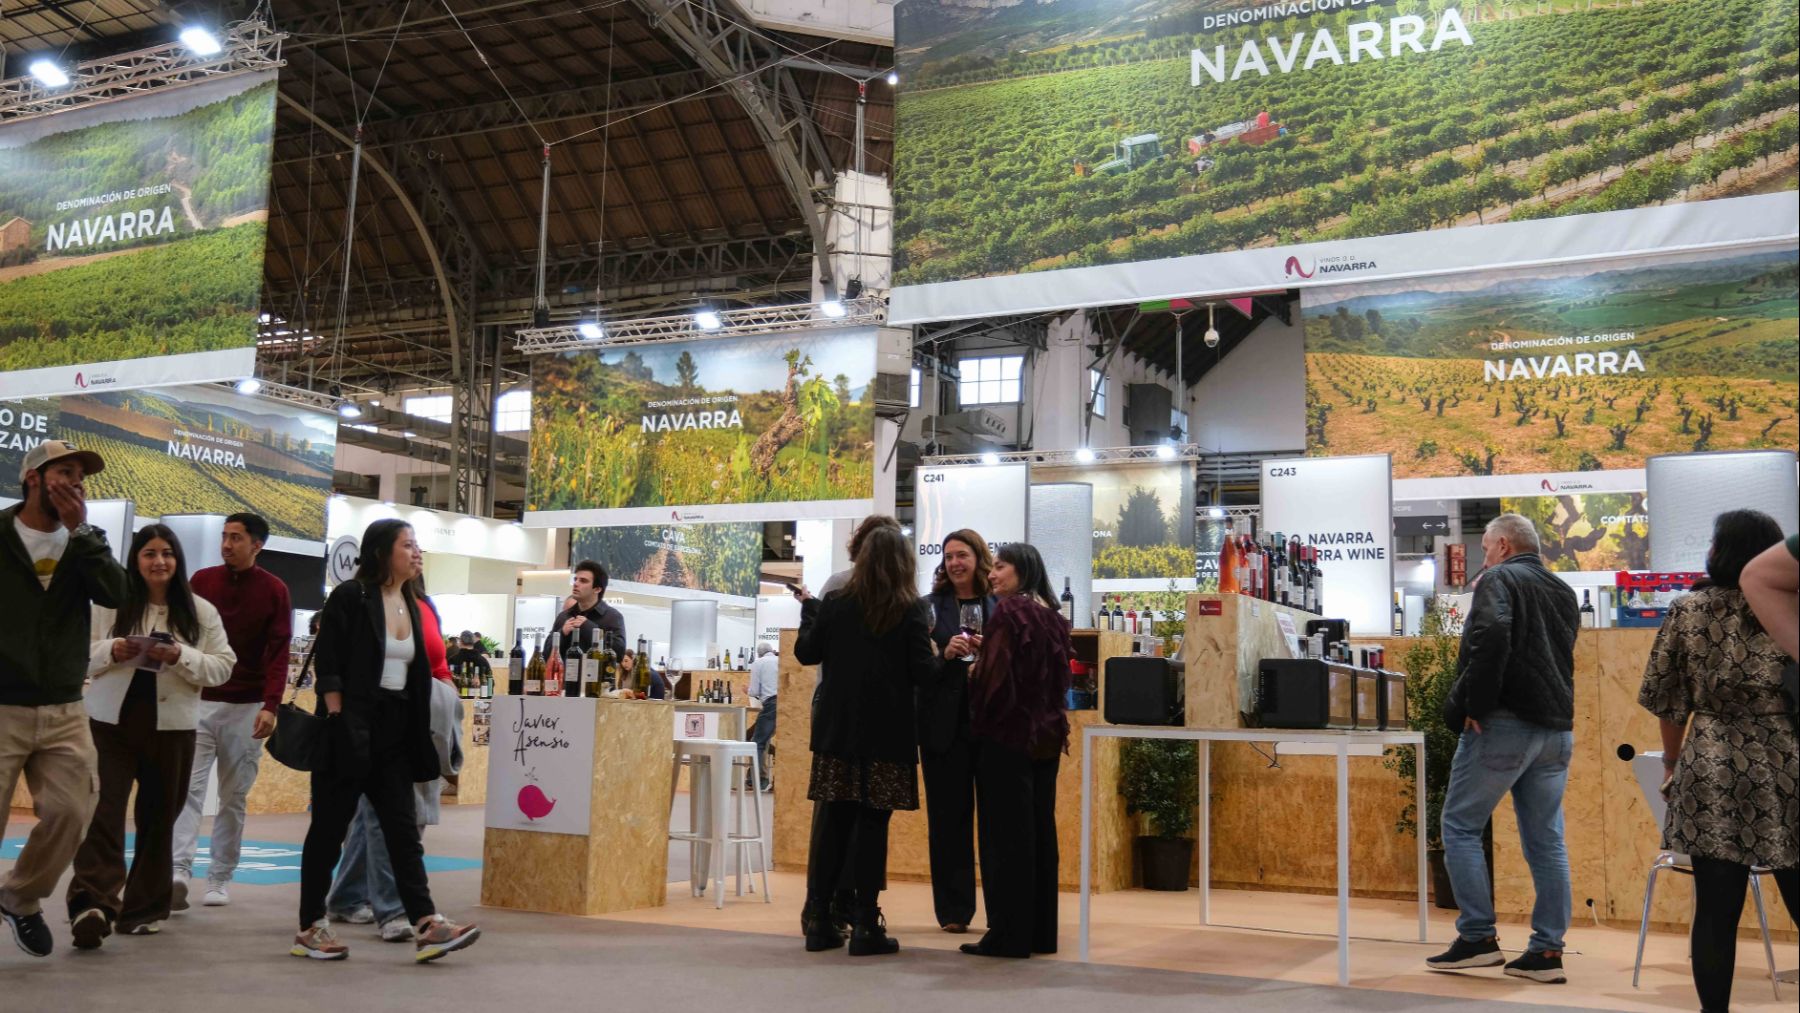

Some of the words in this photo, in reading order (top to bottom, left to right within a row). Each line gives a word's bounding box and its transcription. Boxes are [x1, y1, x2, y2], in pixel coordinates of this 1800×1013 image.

[1190, 8, 1473, 87] NAVARRA
[57, 192, 121, 211] DENOMINACIÓN
[124, 189, 136, 199] DE
[137, 184, 171, 197] ORIGEN
[46, 205, 175, 251] NAVARRA
[1319, 261, 1376, 273] NAVARRA
[1491, 337, 1573, 350] DENOMINACIÓN
[1576, 336, 1590, 344] DE
[1593, 332, 1635, 342] ORIGEN
[1484, 349, 1646, 382] NAVARRA
[648, 398, 700, 408] DENOMINACIÓN
[712, 395, 738, 403] ORIGEN
[0, 408, 14, 426] O
[20, 412, 48, 433] DE
[642, 409, 744, 433] NAVARRA
[0, 430, 51, 452] ZAN
[167, 440, 246, 469] NAVARRA
[923, 474, 944, 483] C241
[1270, 467, 1296, 477] C243
[662, 529, 686, 544] CAVA
[1092, 530, 1112, 538] ONA
[1309, 532, 1374, 545] NAVARRA
[919, 543, 943, 555] BOD
[1316, 549, 1343, 561] RRA
[1347, 547, 1385, 560] WINE
[1194, 559, 1219, 570] CAV
[513, 697, 560, 733] Javier
[514, 730, 570, 766] Asensio
